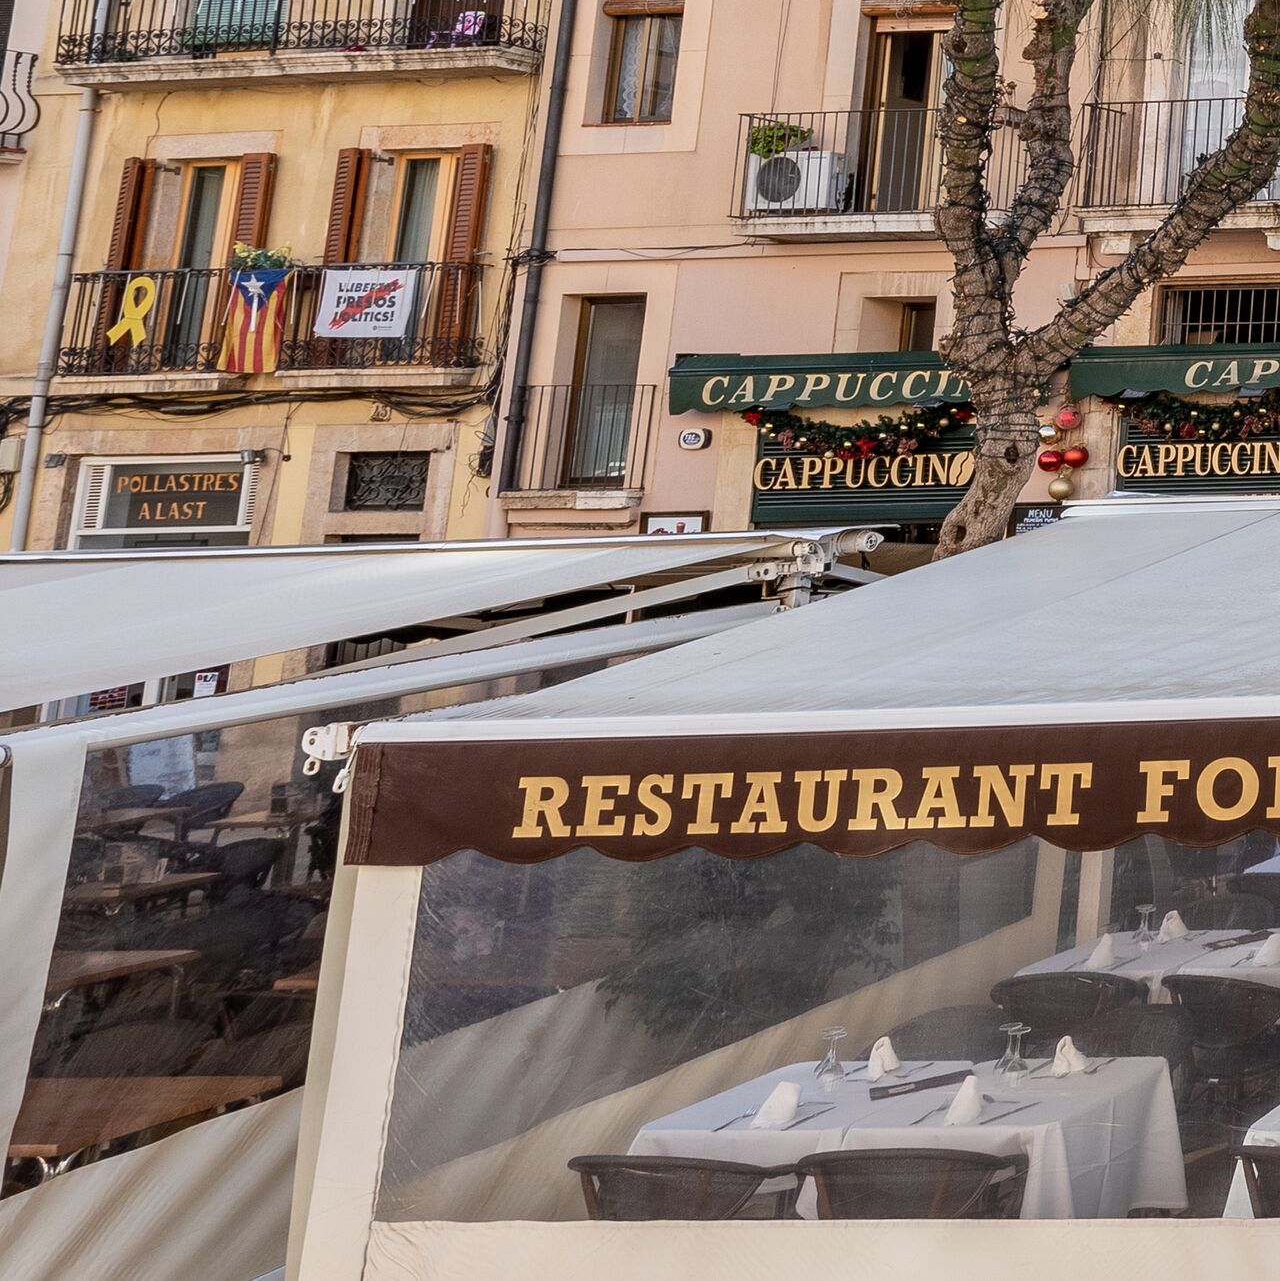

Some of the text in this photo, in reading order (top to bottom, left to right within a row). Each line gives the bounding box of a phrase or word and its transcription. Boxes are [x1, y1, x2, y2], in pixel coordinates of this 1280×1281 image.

[116, 473, 241, 493] POLLASTRES
[154, 501, 207, 520] LAST
[511, 761, 1094, 839] RESTAURANT
